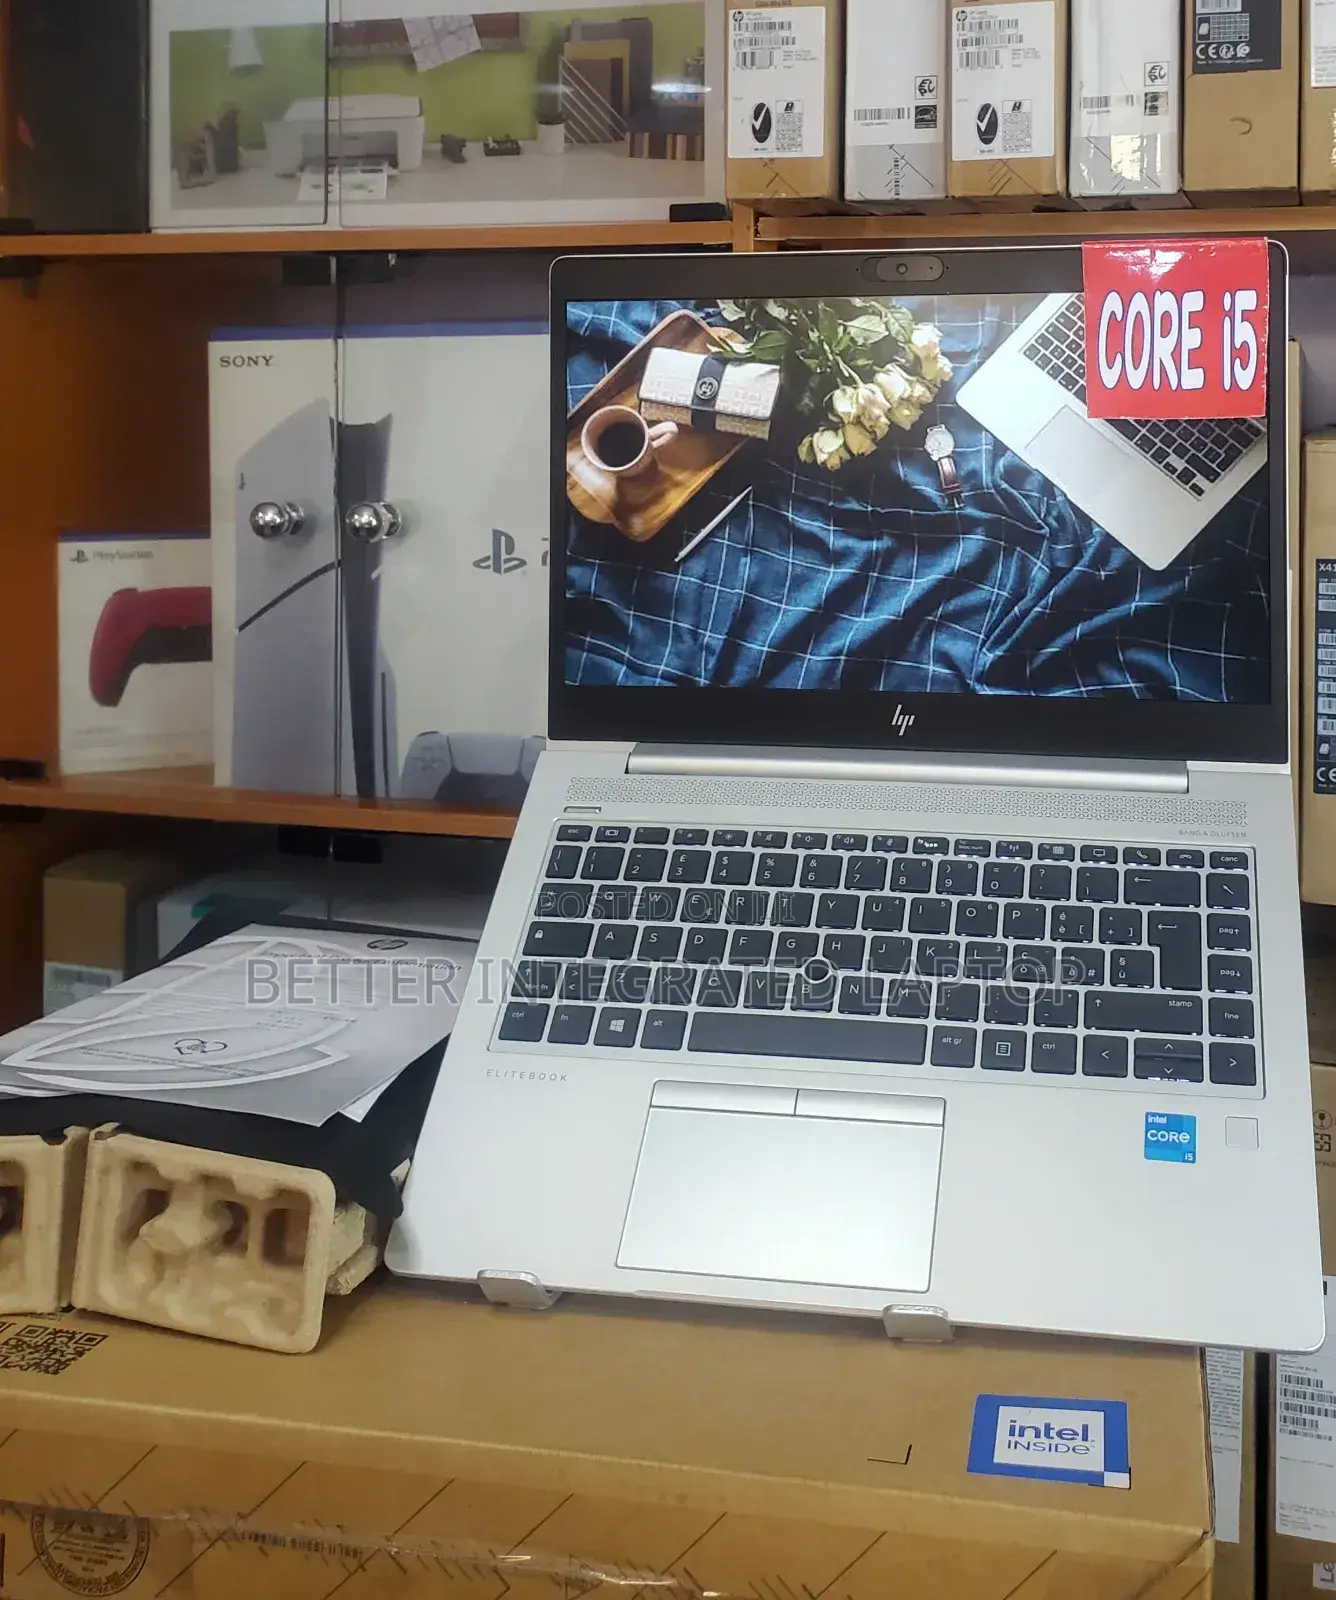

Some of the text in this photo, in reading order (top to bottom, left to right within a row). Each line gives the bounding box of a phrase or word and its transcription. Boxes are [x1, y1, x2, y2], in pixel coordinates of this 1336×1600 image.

[1098, 289, 1258, 391] CORE i5
[219, 355, 275, 368] SONY
[891, 704, 916, 736] hp
[1178, 829, 1201, 837] BANG
[854, 874, 860, 882] 7
[604, 891, 614, 900] Q
[649, 893, 662, 902] W
[692, 894, 700, 904] E
[736, 897, 745, 906] R
[828, 901, 836, 909] Y
[873, 903, 881, 911] U
[1013, 911, 1020, 919] P
[605, 931, 613, 940] A
[650, 933, 657, 942] S
[694, 935, 703, 944] D
[740, 937, 747, 945] F
[787, 939, 795, 948] G
[832, 941, 841, 950] H
[879, 944, 885, 952] J
[926, 947, 936, 956] K
[974, 950, 981, 959] L
[616, 972, 625, 982] Z
[756, 979, 765, 989] V
[801, 984, 810, 994] B
[850, 984, 859, 994] N
[899, 988, 908, 997] M
[486, 1068, 569, 1082] ELITEBOOK
[1147, 1115, 1168, 1124] intel
[1184, 1152, 1194, 1161] i5
[1008, 1419, 1090, 1442] intel
